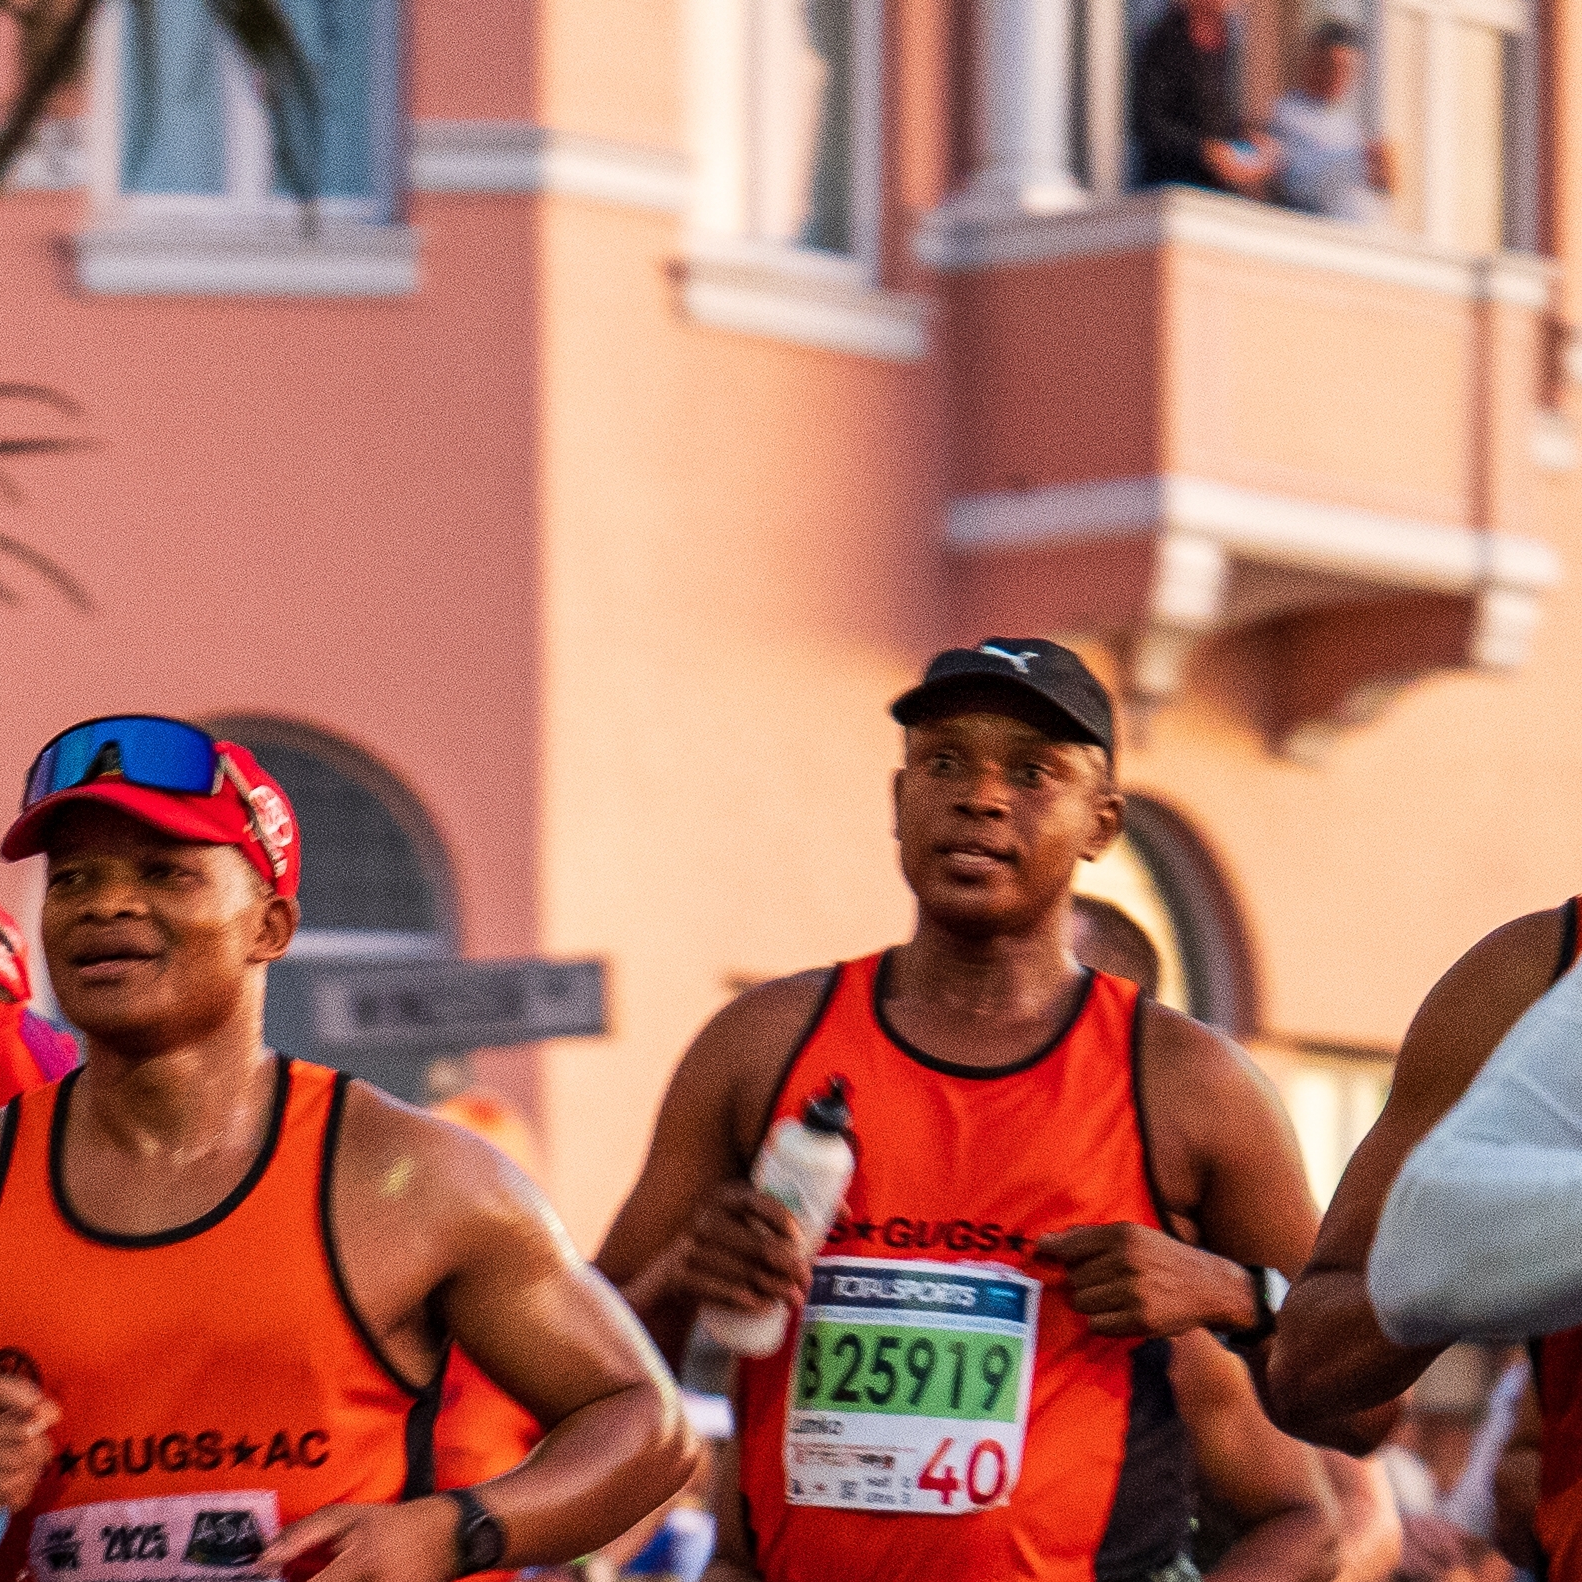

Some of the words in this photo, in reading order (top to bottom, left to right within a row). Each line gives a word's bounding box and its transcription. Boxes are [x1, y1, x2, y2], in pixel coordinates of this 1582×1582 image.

[882, 1216, 1004, 1252] GUGS
[86, 1430, 224, 1478] GUGS
[262, 1428, 330, 1469] AC
[918, 1436, 1008, 1507] 40
